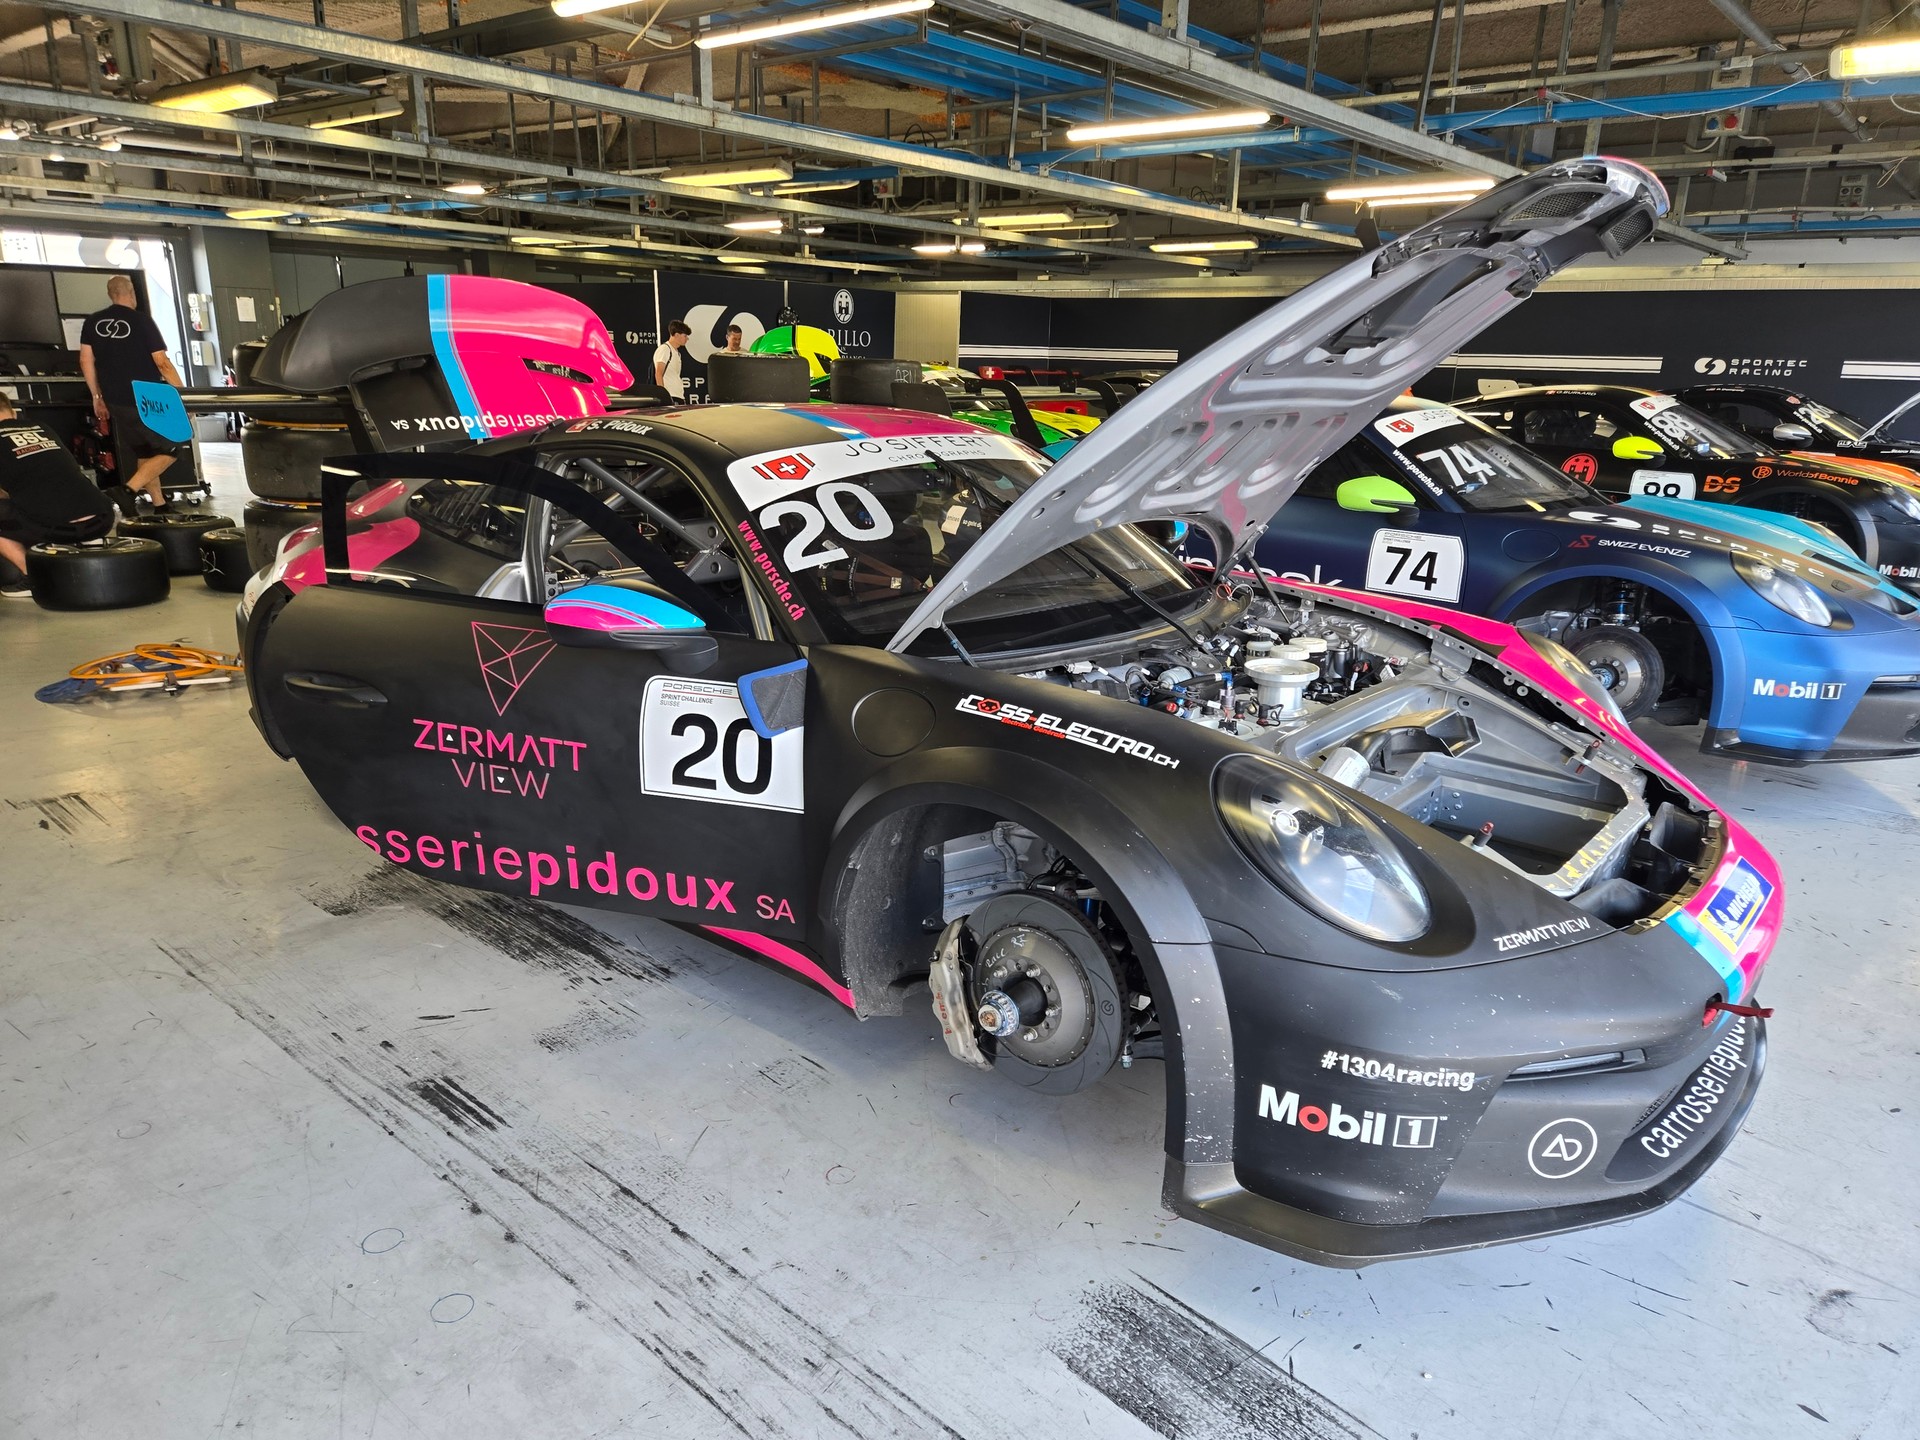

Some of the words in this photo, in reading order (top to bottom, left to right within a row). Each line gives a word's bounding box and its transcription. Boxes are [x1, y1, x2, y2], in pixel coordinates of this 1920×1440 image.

[828, 328, 871, 348] RILLO
[1729, 368, 1793, 377] RACING
[1731, 359, 1808, 367] SPORTEC
[390, 419, 410, 431] SA
[588, 419, 600, 431] S.
[602, 419, 655, 436] Pidoux
[10, 432, 49, 447] BSL
[845, 441, 882, 457] JO
[886, 435, 991, 451] SIFFERT
[888, 449, 986, 462] CHROOGRAPHS
[1416, 444, 1497, 487] 74
[1393, 449, 1444, 496] www.porsche.ch
[1703, 475, 1742, 494] DS
[759, 482, 894, 573] 20
[1598, 539, 1638, 549] SWIZZ
[1638, 542, 1691, 558] EVENZZ
[737, 520, 806, 621] www.porsche.ch
[1385, 546, 1438, 591] 74
[1879, 564, 1918, 578] Mobil
[661, 693, 681, 701] SPRINT
[680, 695, 714, 705] CHALLENGE
[663, 682, 733, 696] PORSCHE
[1753, 678, 1819, 699] Mobil
[659, 699, 681, 708] SUISSE
[412, 718, 587, 772] ZERMATT
[671, 713, 773, 795] 20
[451, 758, 550, 800] VIEW
[1726, 872, 1761, 921] MICHELIN
[756, 894, 796, 925] SA
[1320, 1050, 1475, 1092] #1304racing
[1259, 1083, 1387, 1146] Mobil
